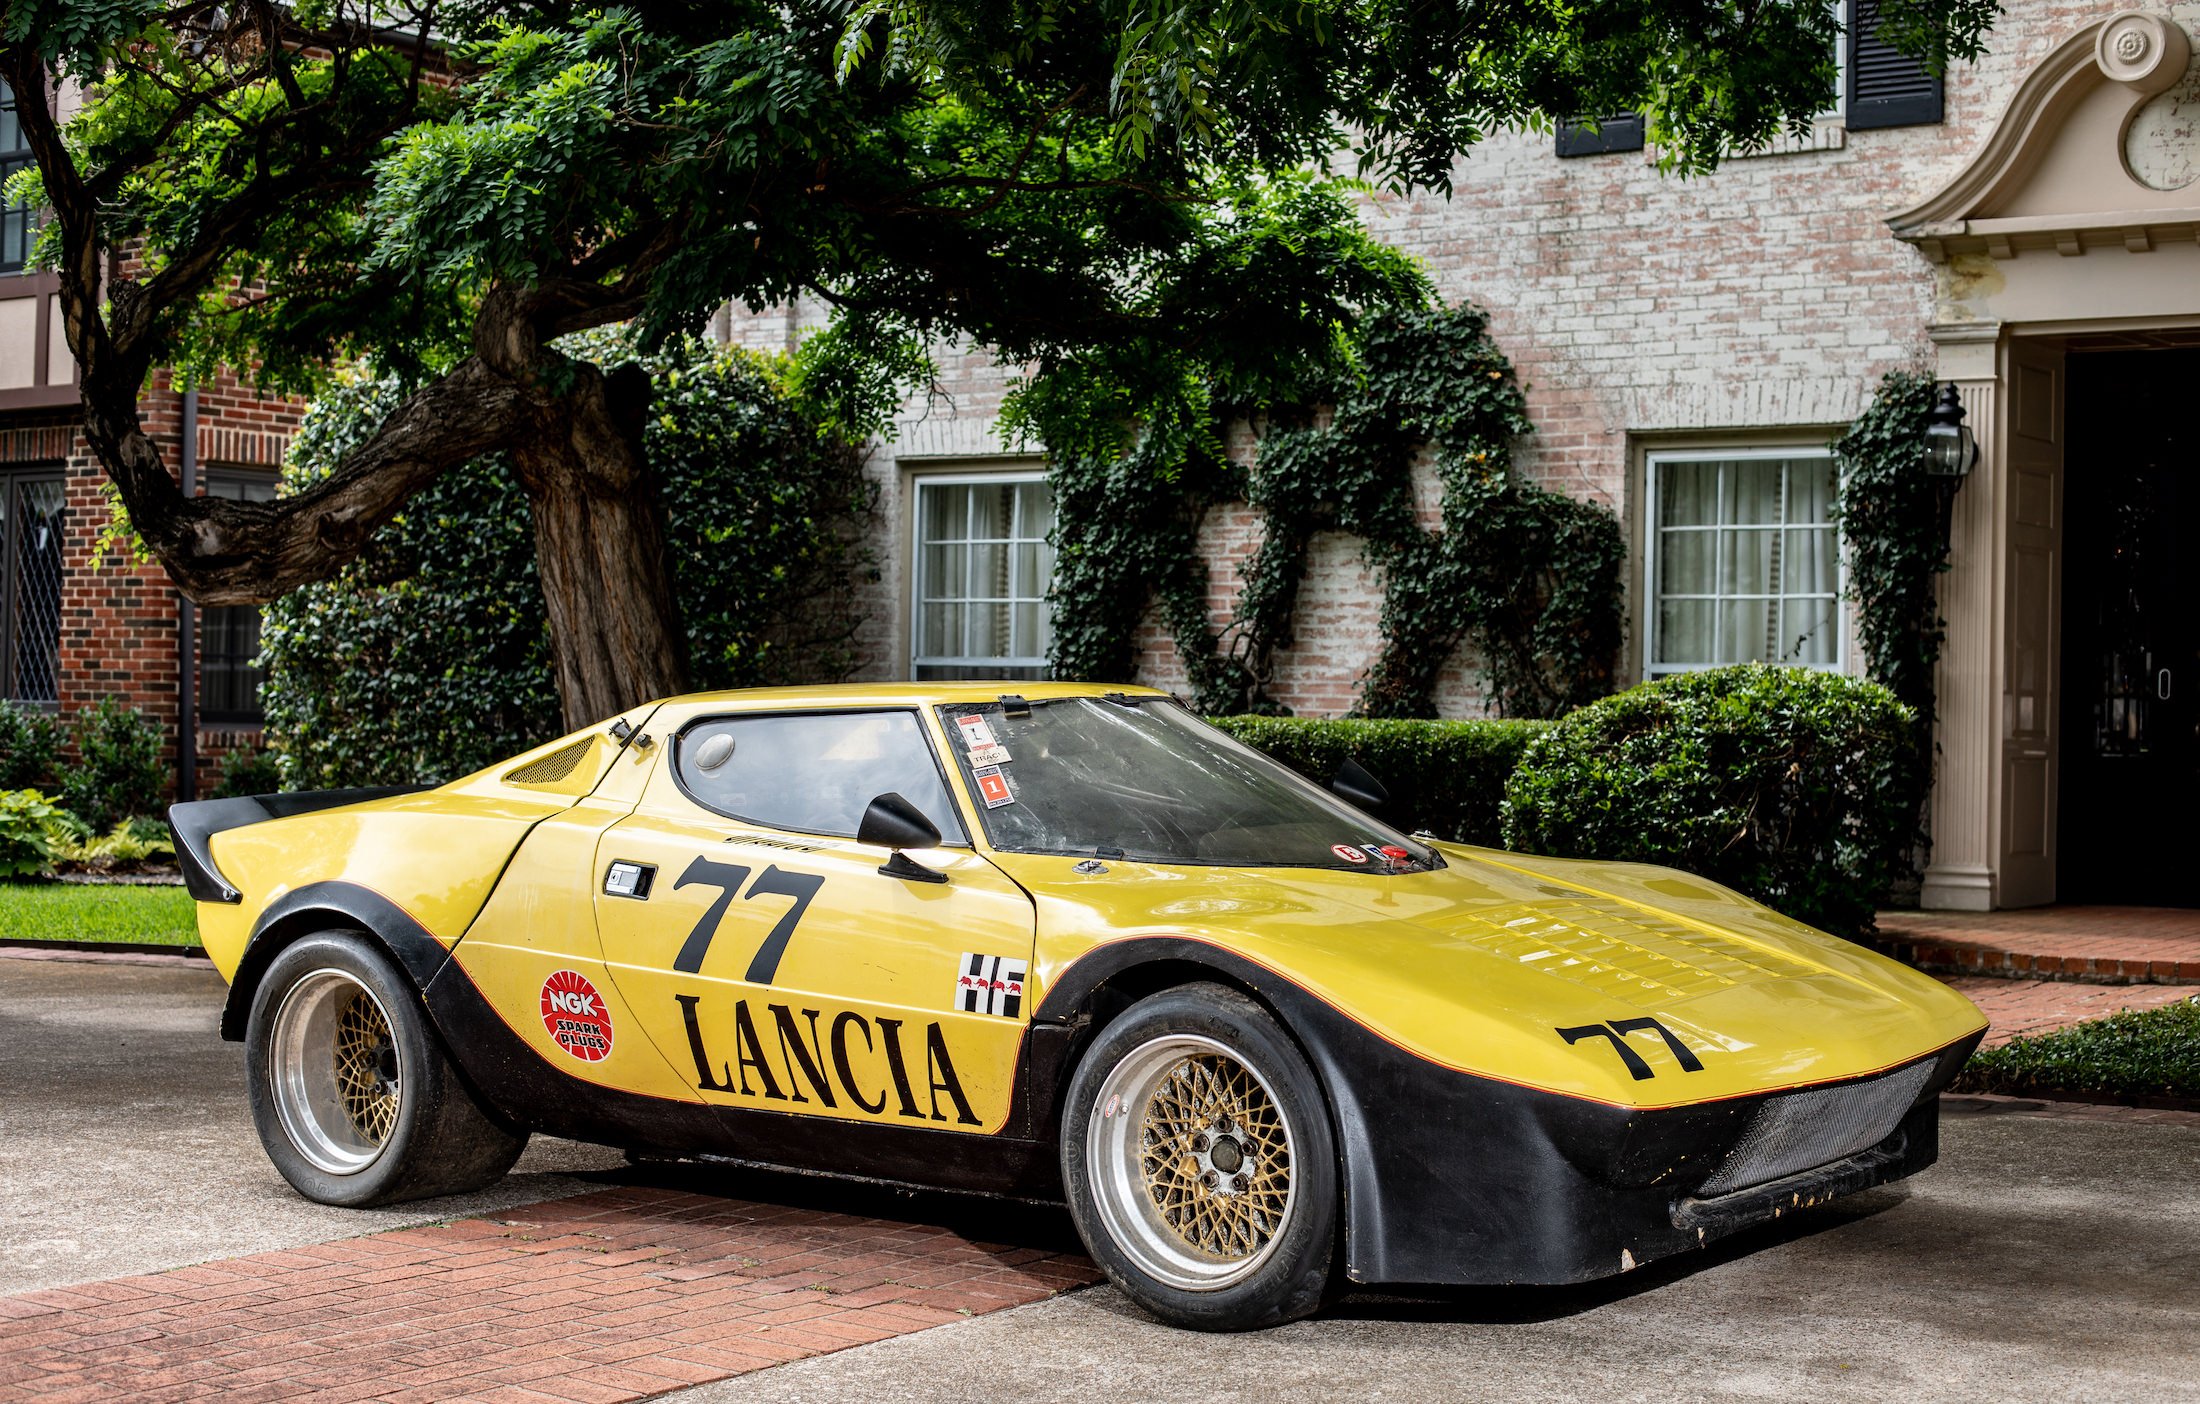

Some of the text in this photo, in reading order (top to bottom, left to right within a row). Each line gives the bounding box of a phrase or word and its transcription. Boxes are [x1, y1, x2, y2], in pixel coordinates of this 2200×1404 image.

[986, 780, 1002, 794] 1
[673, 854, 826, 985] 77
[548, 987, 598, 1018] NGK
[954, 952, 1029, 1018] HF
[556, 1019, 602, 1036] SPARK
[559, 1033, 606, 1049] PLUGS
[1554, 1016, 1705, 1082] 77
[675, 994, 983, 1127] LANCIA
